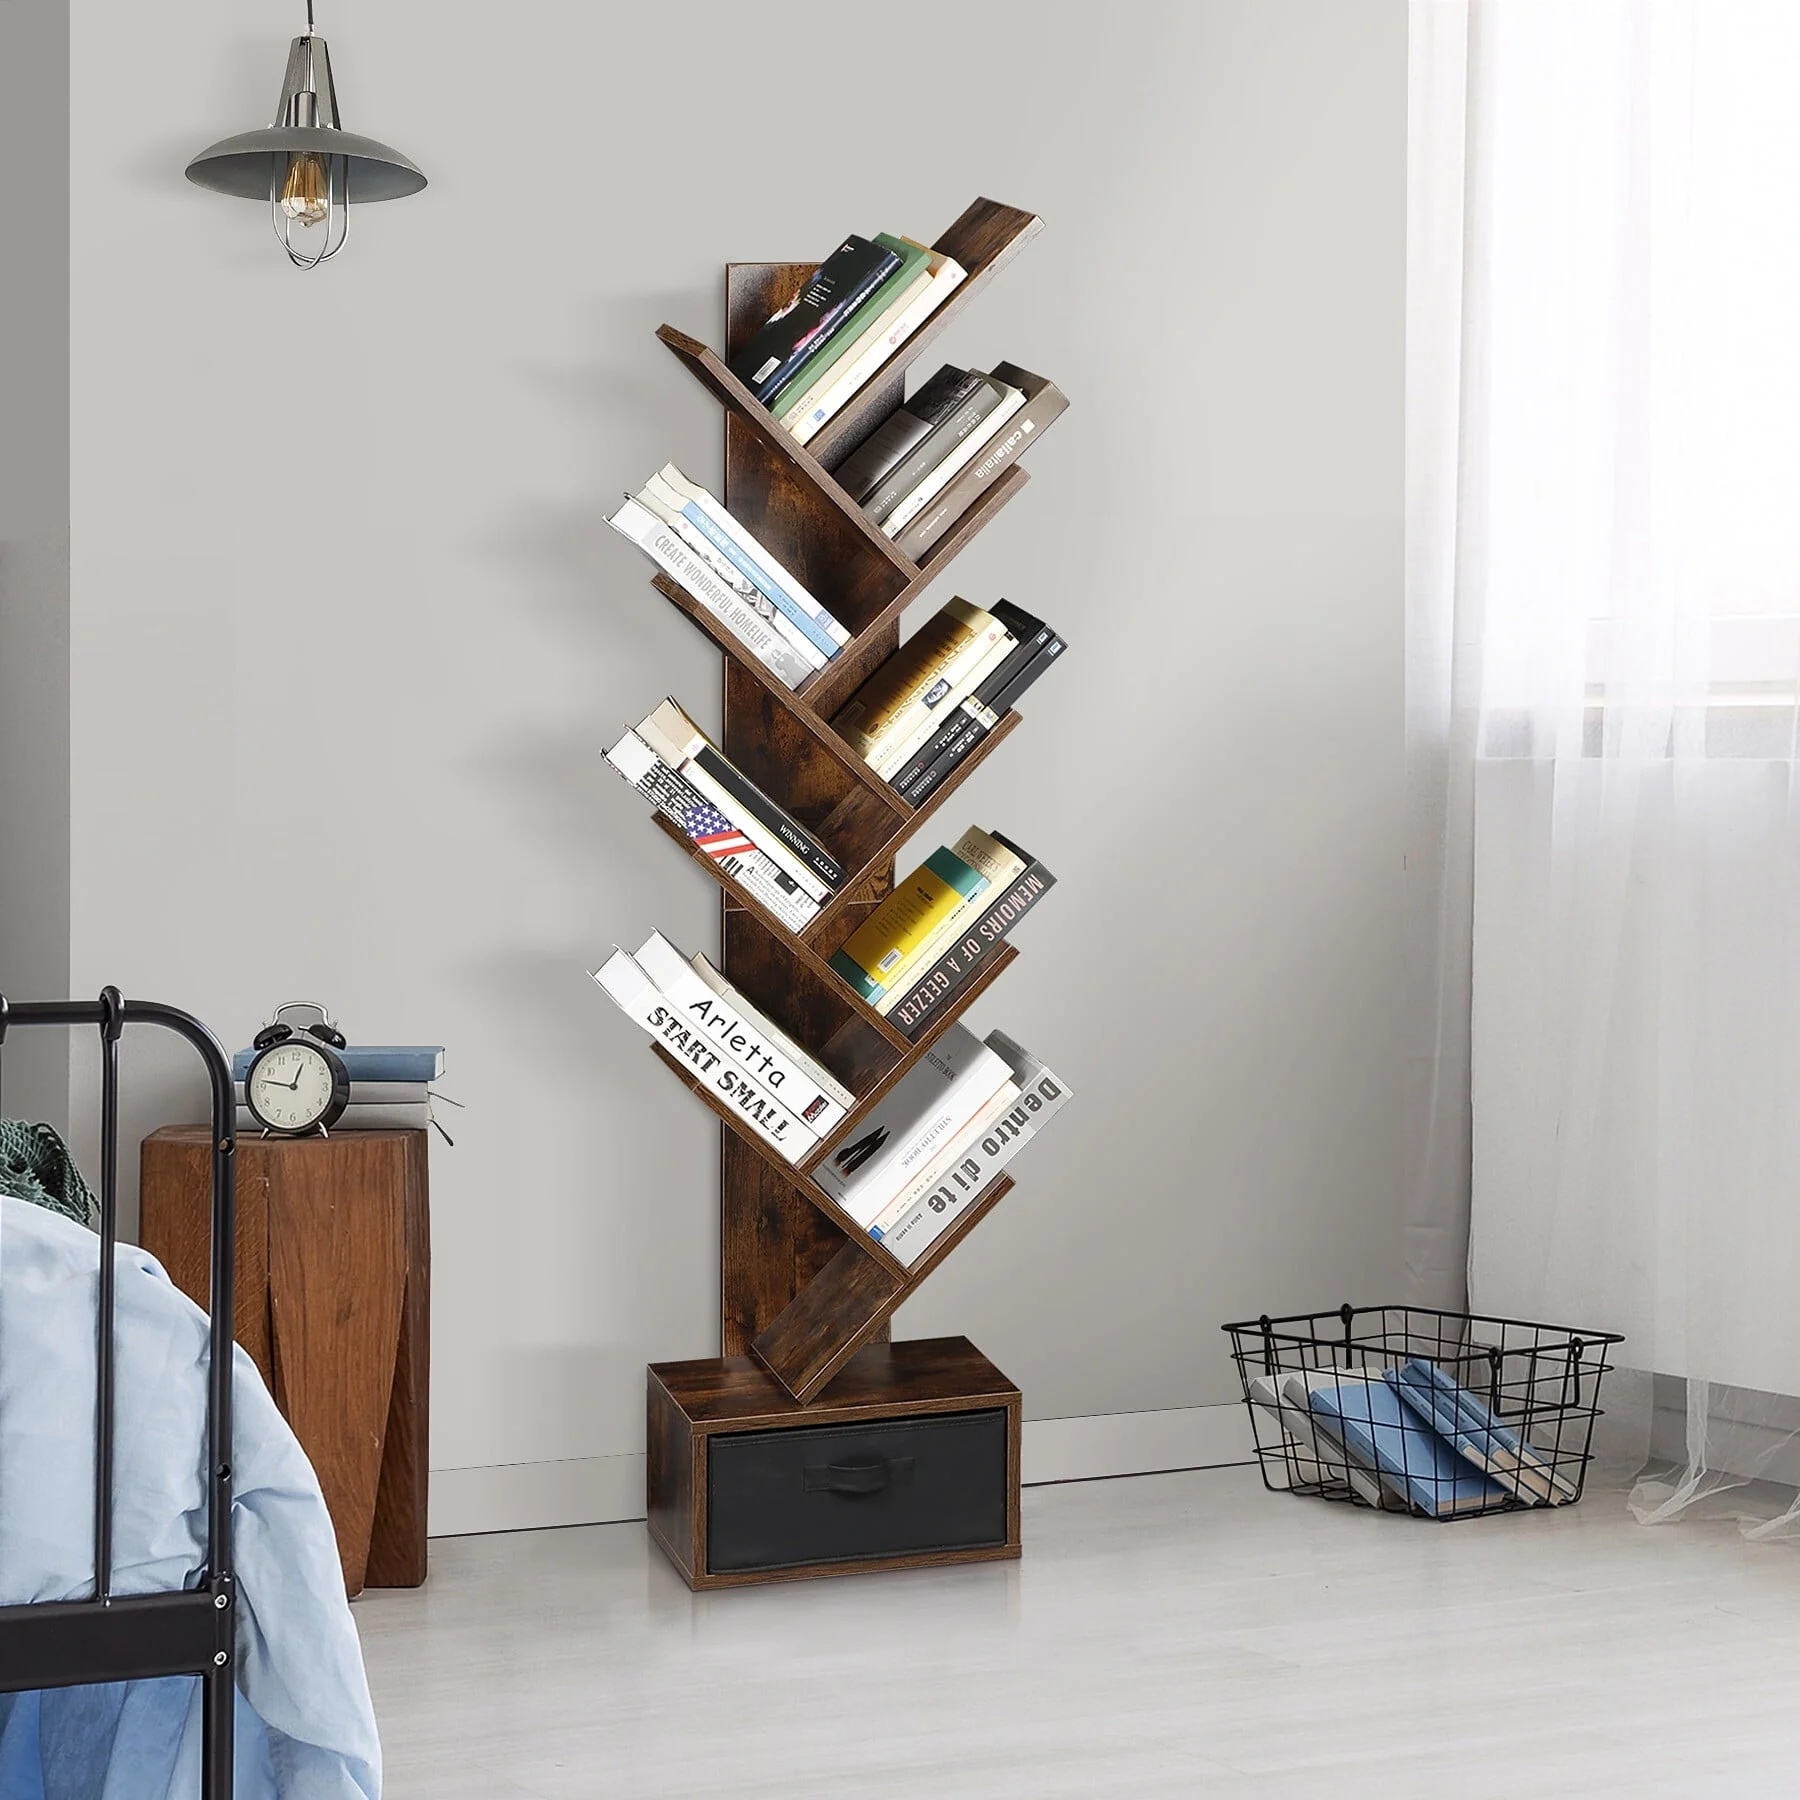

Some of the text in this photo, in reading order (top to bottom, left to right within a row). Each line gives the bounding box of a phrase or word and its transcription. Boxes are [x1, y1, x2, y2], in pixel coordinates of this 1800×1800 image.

[654, 534, 688, 568] CREATE
[683, 561, 735, 614] WONDERFUL
[729, 607, 773, 650] HOMELIFE
[779, 824, 810, 855] WINNING
[979, 874, 1044, 942] MEMOIRS
[946, 957, 962, 973] A
[964, 938, 981, 962] OF
[897, 971, 950, 1026] GEEZER
[646, 1006, 721, 1074] START
[716, 1071, 790, 1142] SMALL
[689, 999, 786, 1089] Arletta
[927, 1077, 1062, 1214] Dentro di te
